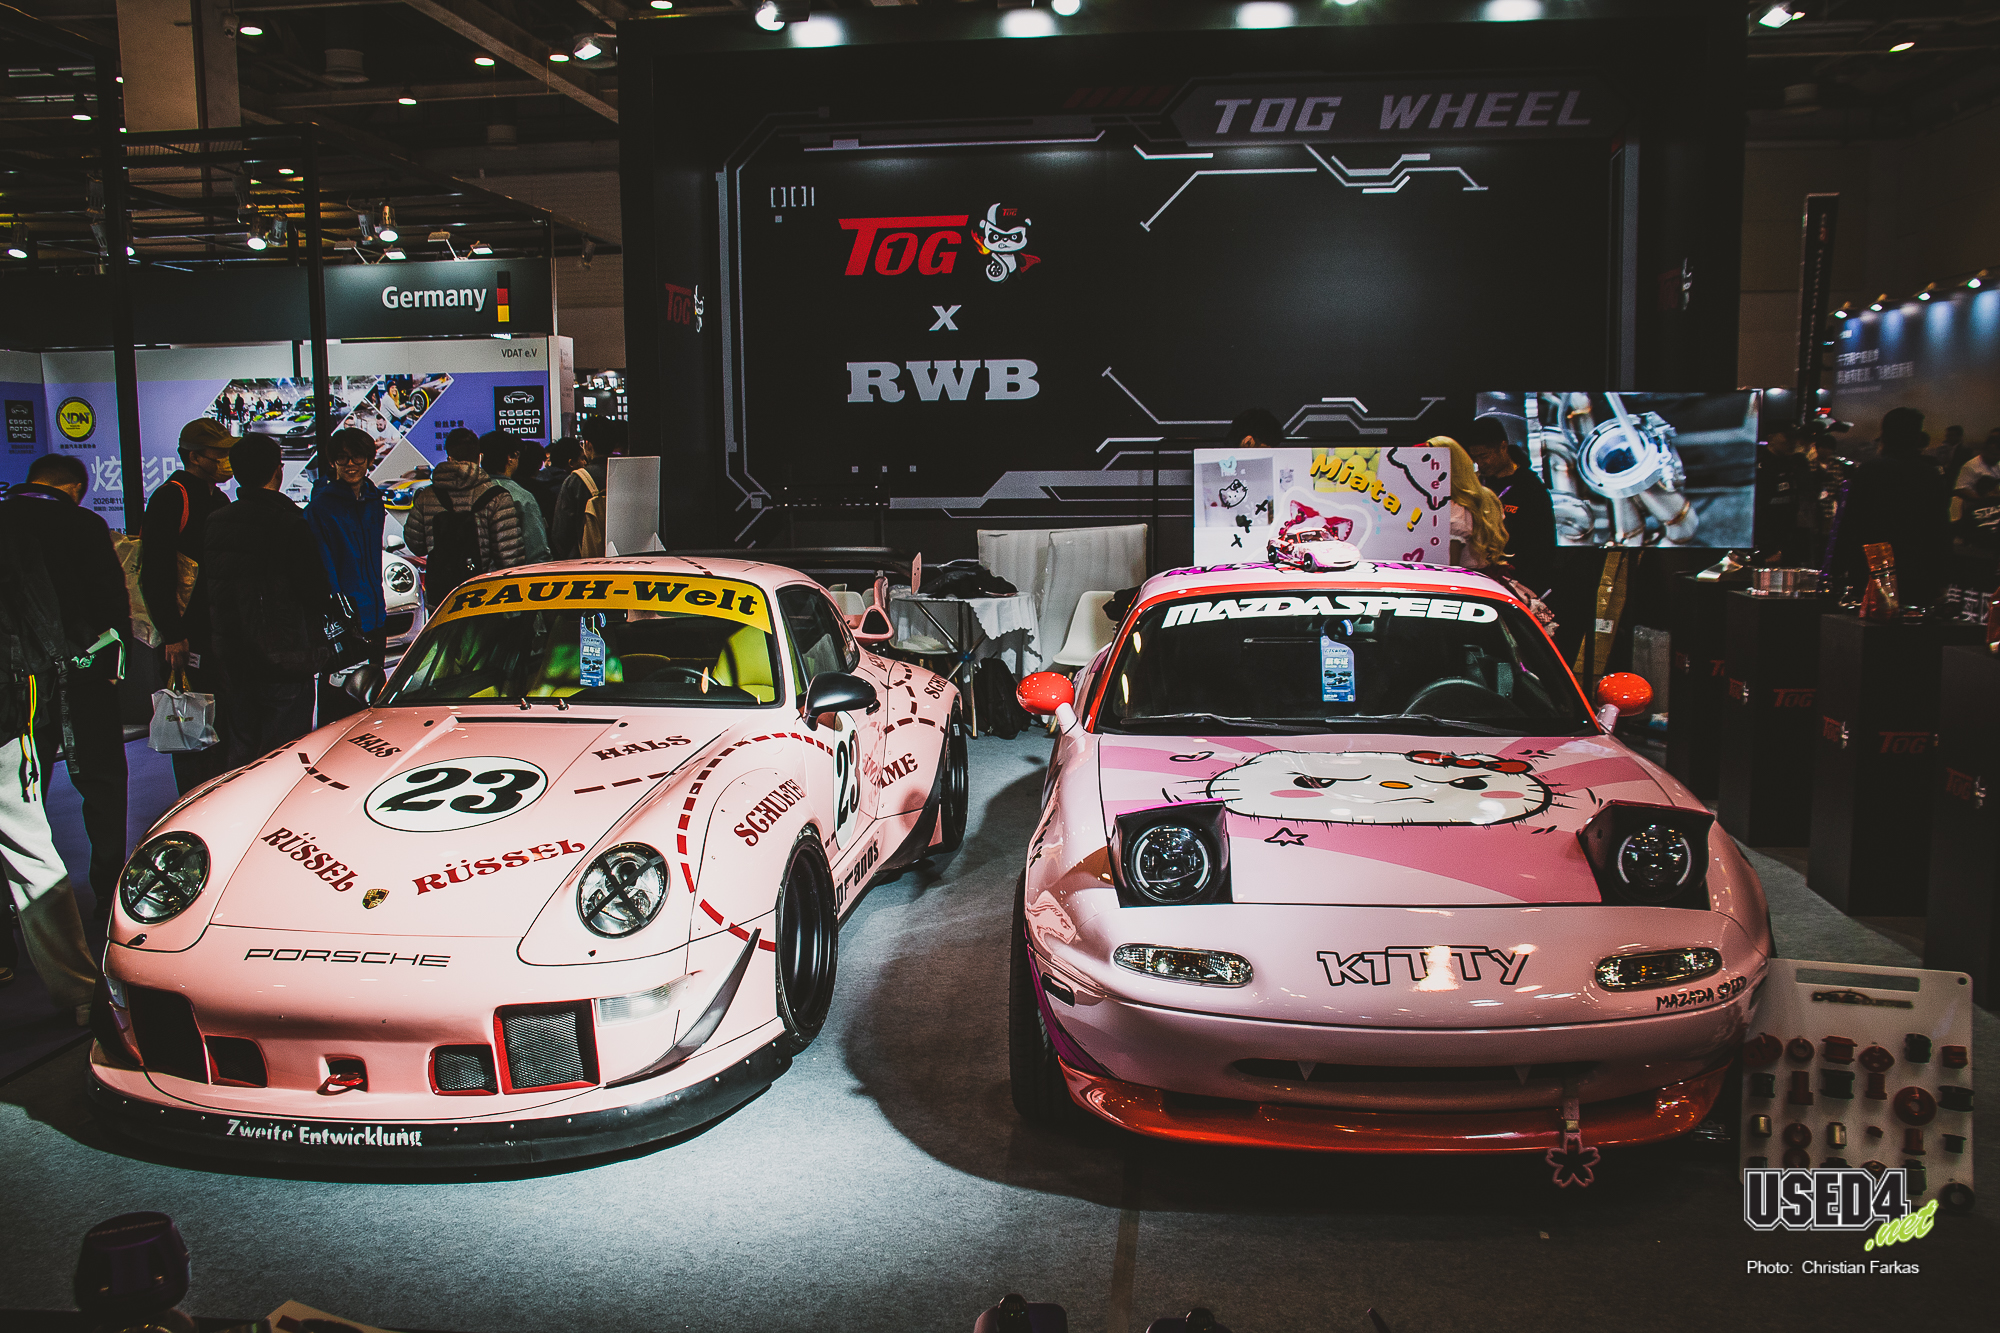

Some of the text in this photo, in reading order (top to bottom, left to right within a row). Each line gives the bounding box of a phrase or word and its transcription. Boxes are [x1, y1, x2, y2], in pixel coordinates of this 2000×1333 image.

[1213, 90, 1592, 134] TOG WHEEL
[838, 214, 969, 276] TOG
[382, 286, 488, 312] Germany
[665, 283, 693, 325] TOG
[501, 348, 523, 358] VDAT
[847, 358, 1040, 403] RWB
[498, 409, 541, 417] ESSEN
[499, 418, 541, 426] MOTOR
[1310, 453, 1401, 515] Miata
[1430, 458, 1440, 547] hello
[448, 579, 759, 616] RAUH-Welt
[1161, 596, 1498, 628] MAZDASPEED
[1773, 688, 1816, 708] TOG
[347, 733, 403, 759] HALS
[592, 734, 693, 762] HALS
[1878, 731, 1931, 754] TOG
[375, 766, 540, 815] 23
[837, 730, 860, 831] 23
[734, 778, 806, 847] SCHULTE
[261, 826, 360, 893] RÜSSEL
[411, 839, 586, 895] RÜSSEL
[243, 948, 451, 969] PORSCHE
[1317, 945, 1530, 987] KITTY
[227, 1119, 423, 1147] Zweite Entwicklung
